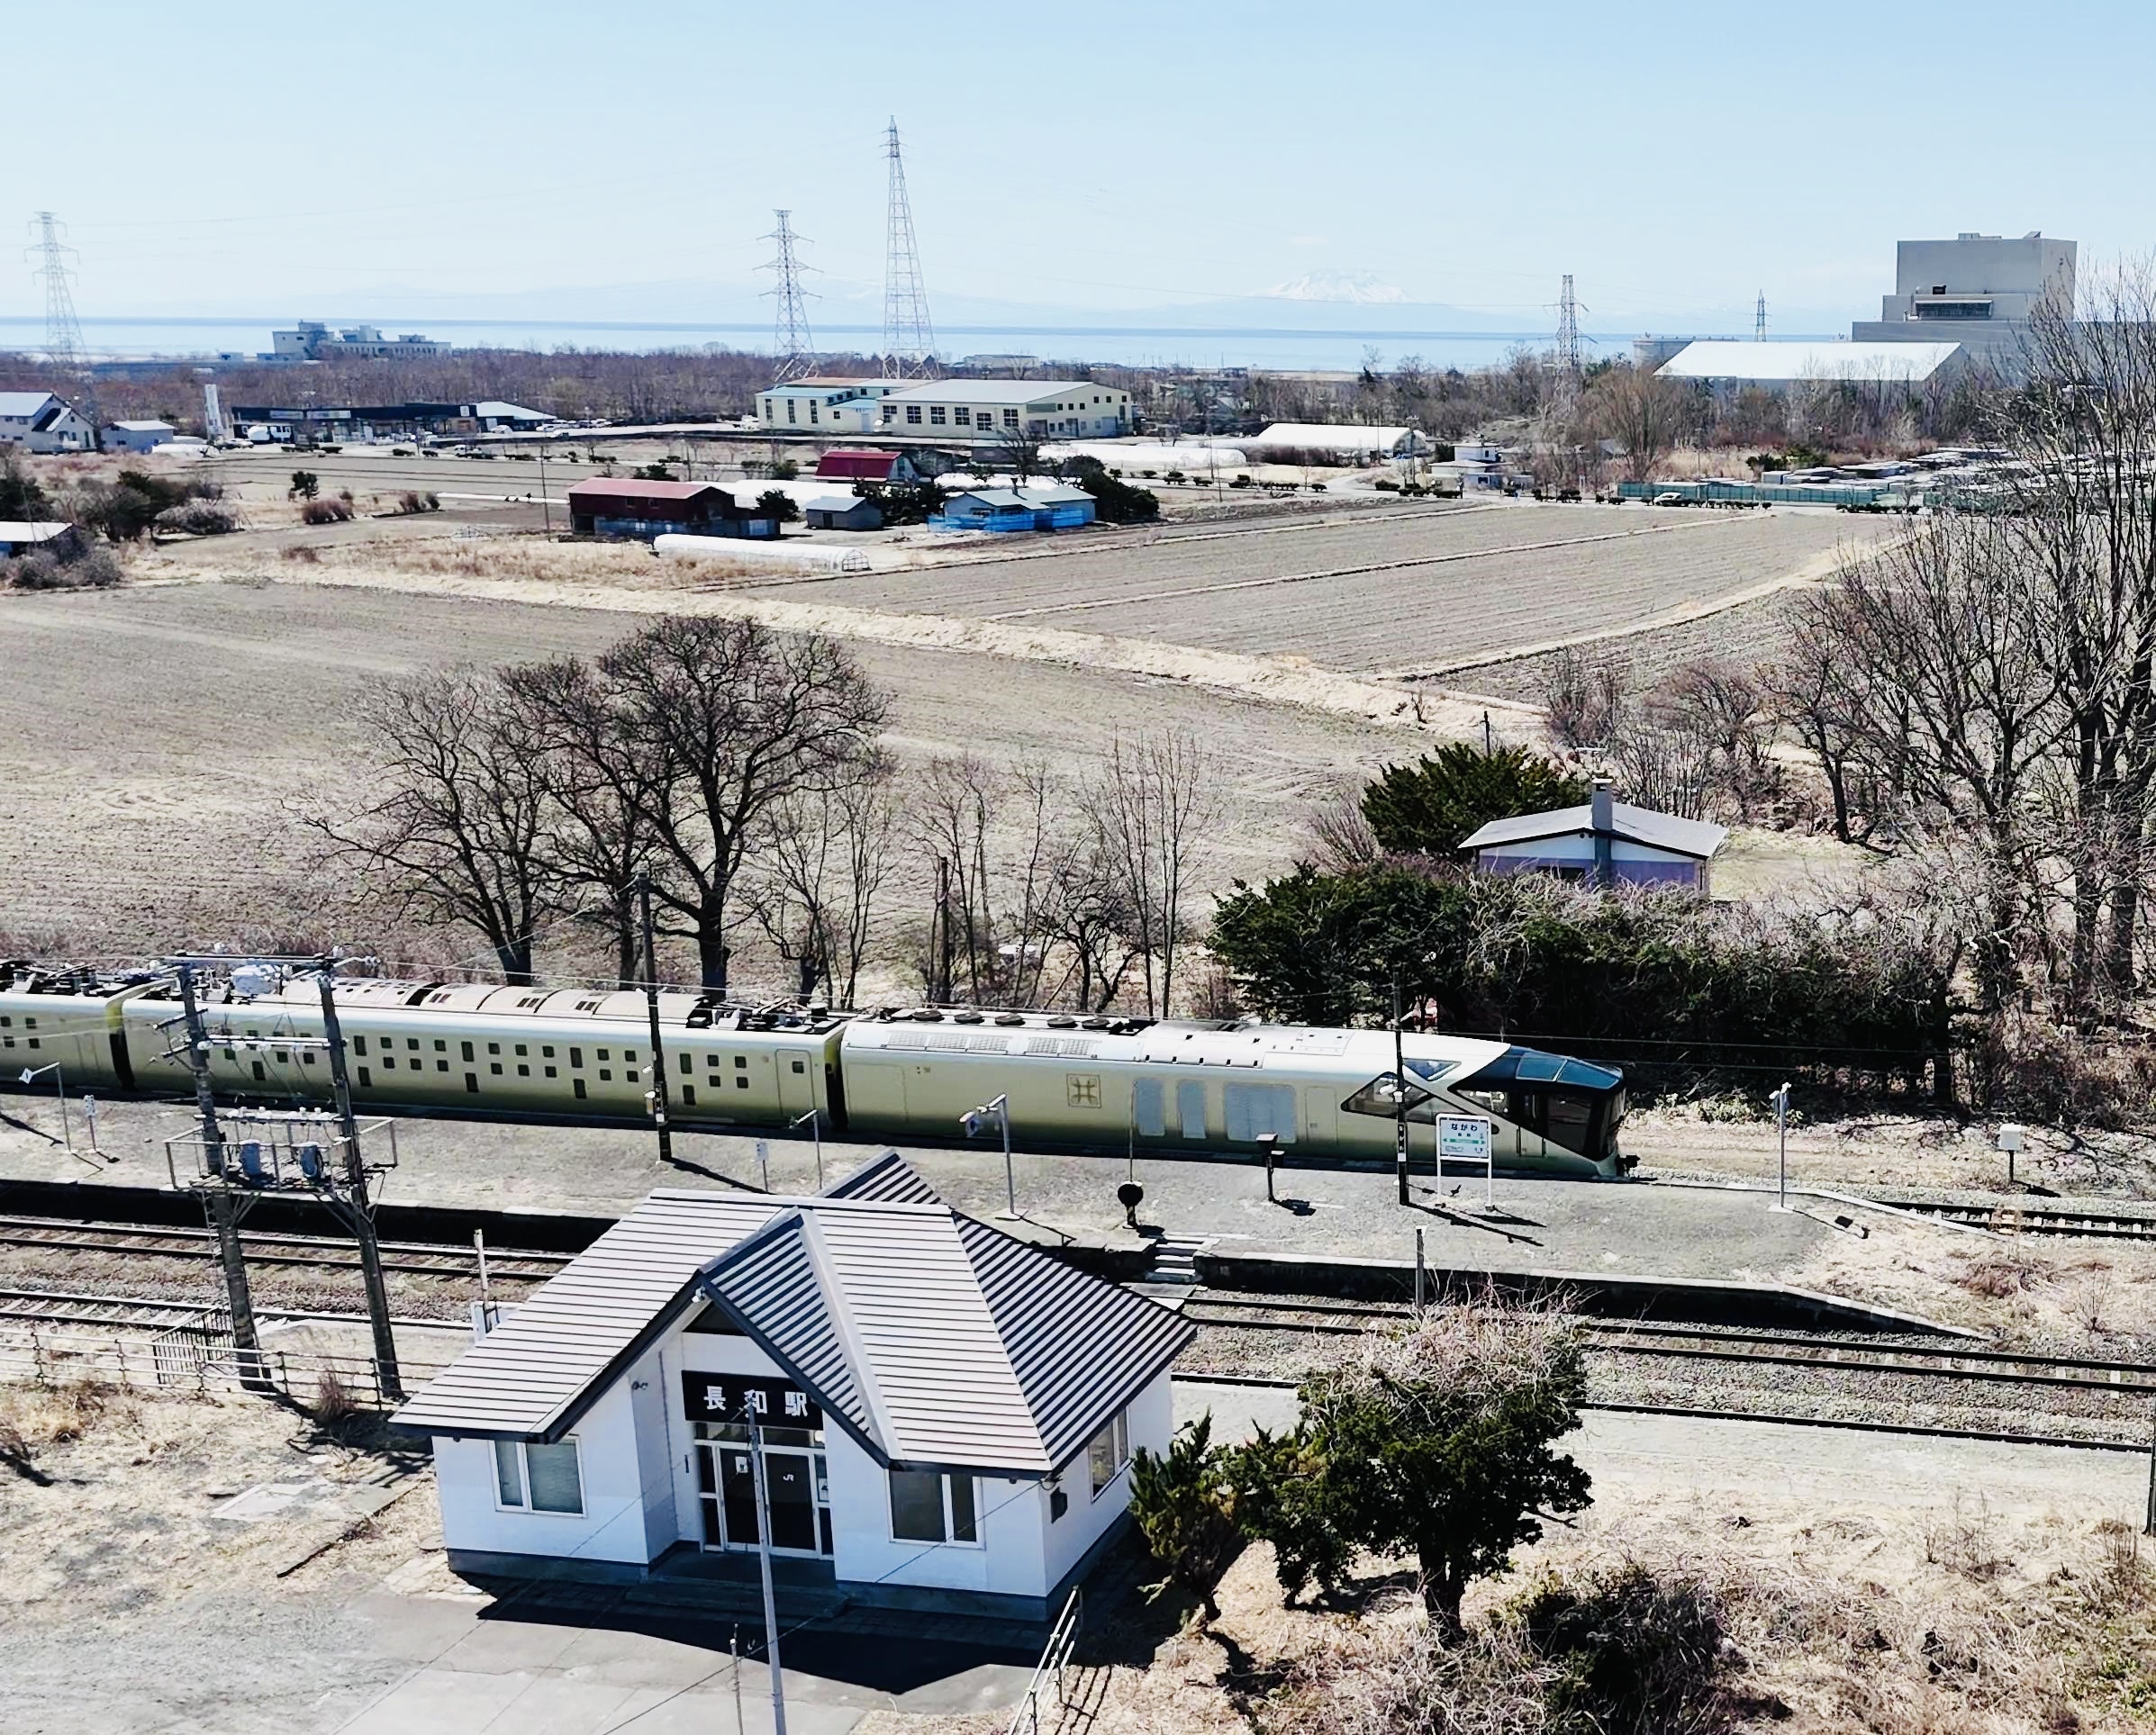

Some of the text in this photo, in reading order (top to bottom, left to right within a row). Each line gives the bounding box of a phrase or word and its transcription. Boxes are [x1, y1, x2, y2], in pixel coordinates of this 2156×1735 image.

[1451, 1123, 1478, 1131] ながわ
[703, 1386, 808, 1418] 長和駅
